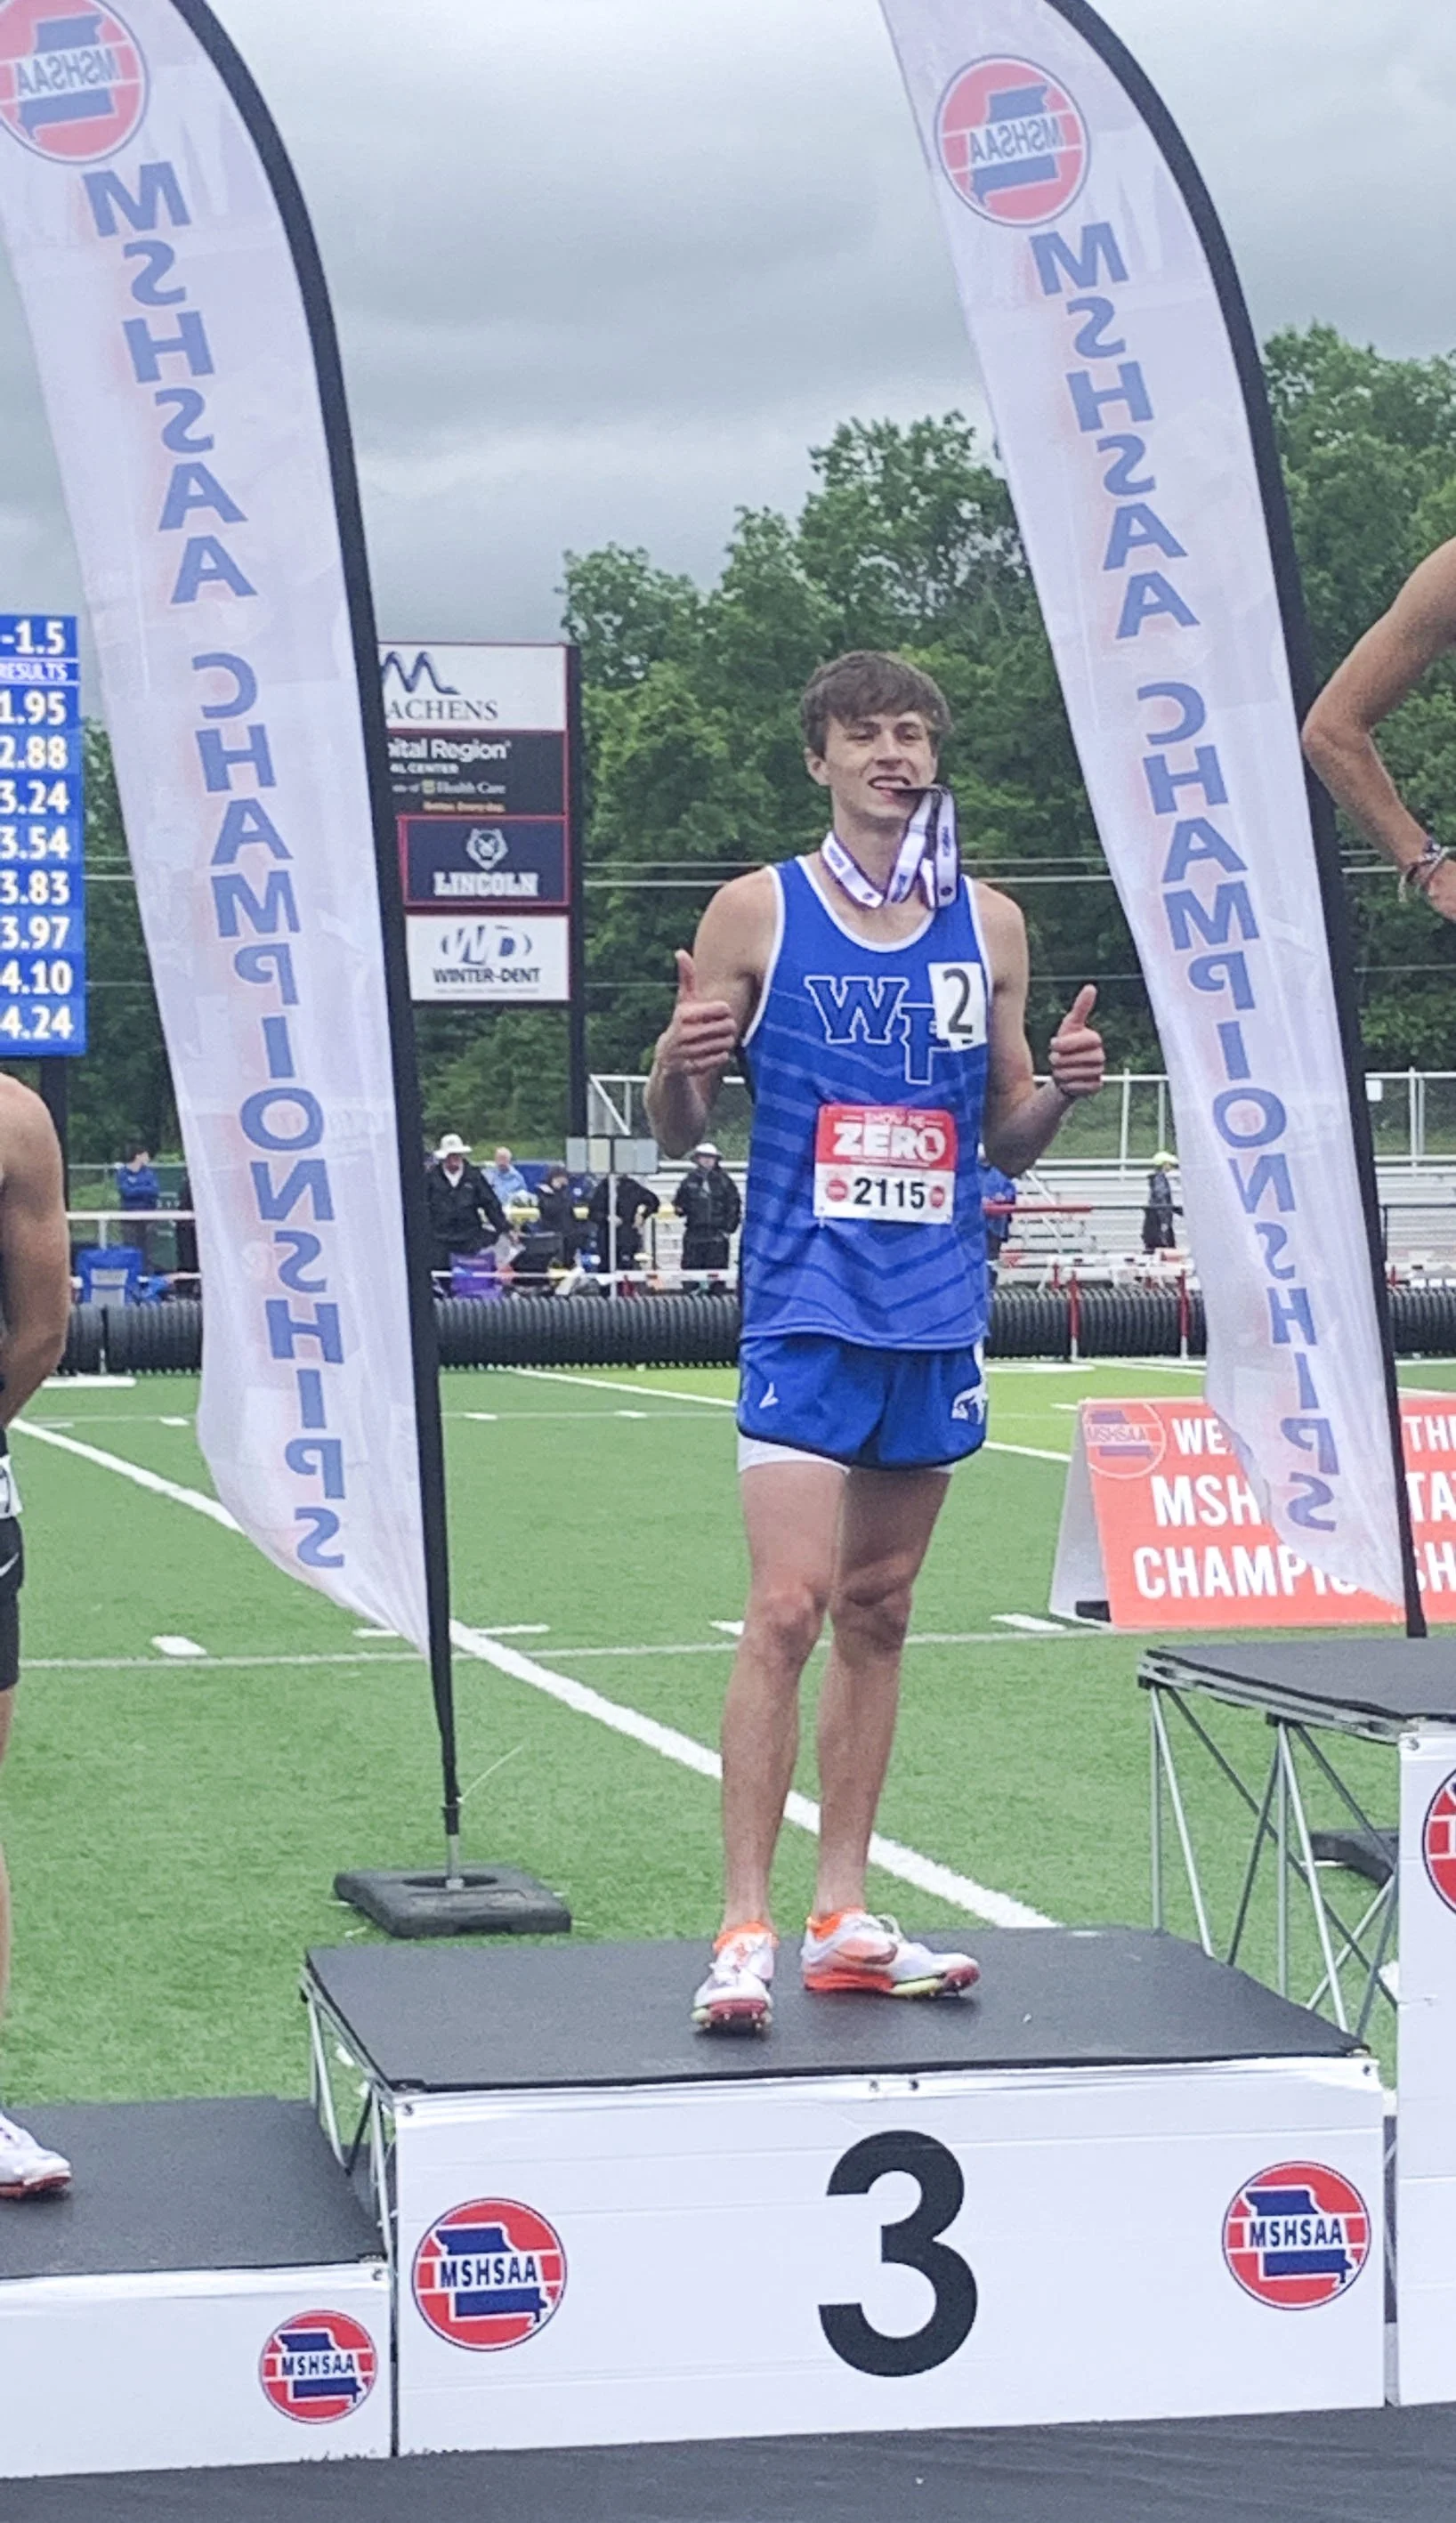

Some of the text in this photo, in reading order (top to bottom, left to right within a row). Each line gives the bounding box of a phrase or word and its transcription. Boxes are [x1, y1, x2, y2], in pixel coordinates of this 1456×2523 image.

[1, 620, 66, 655] -1.5
[388, 699, 498, 721] ACHENS
[388, 738, 507, 763] ital Region
[0, 823, 70, 861] 3.54
[0, 869, 71, 906] 3.83
[433, 871, 539, 897] LINCOLN
[0, 915, 71, 950] 3.97
[0, 959, 74, 995] 4.10
[433, 967, 541, 983] WINTER-DENT
[942, 967, 973, 1034] 2
[0, 1005, 75, 1040] 4.24
[833, 1121, 946, 1162] ZERO
[853, 1177, 926, 1209] 2115
[1151, 1474, 1262, 1527] MSH
[1250, 2217, 1345, 2249] MSHSAA
[817, 2131, 978, 2377] 3
[439, 2255, 538, 2289] MSHSAA
[280, 2353, 356, 2377] MSHSAA
